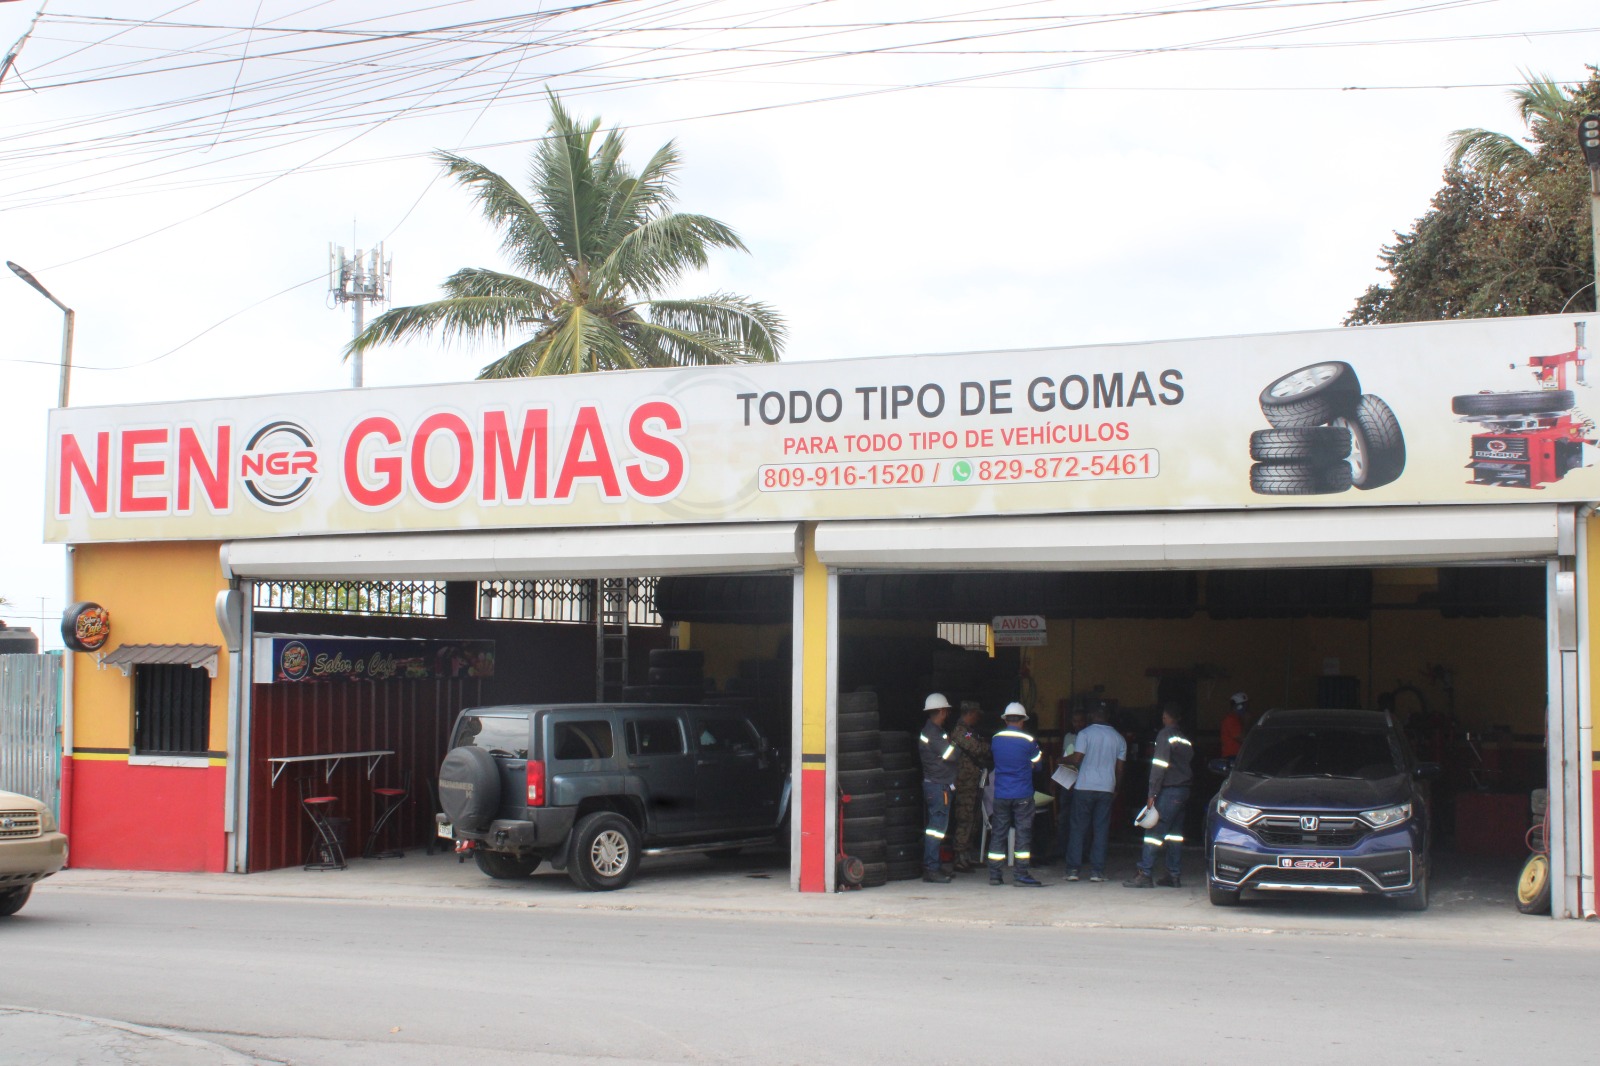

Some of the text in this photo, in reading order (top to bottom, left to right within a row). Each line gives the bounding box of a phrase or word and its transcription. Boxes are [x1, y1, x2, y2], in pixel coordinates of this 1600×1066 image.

[736, 369, 1184, 426] TODO TIPO DE GOMAS
[783, 436, 839, 456] PARA
[843, 432, 903, 454] TODO
[908, 430, 959, 451] TIPO
[964, 428, 994, 449] DE
[1000, 421, 1130, 447] VEHÍCULOS
[59, 425, 230, 515] NEN
[241, 450, 319, 477] NGR
[343, 401, 684, 507] GOMAS
[763, 453, 1151, 489] 809-916-1520 / 829-872-5461
[1002, 618, 1039, 629] AVISO
[313, 652, 352, 676] Sabor
[355, 659, 364, 673] a
